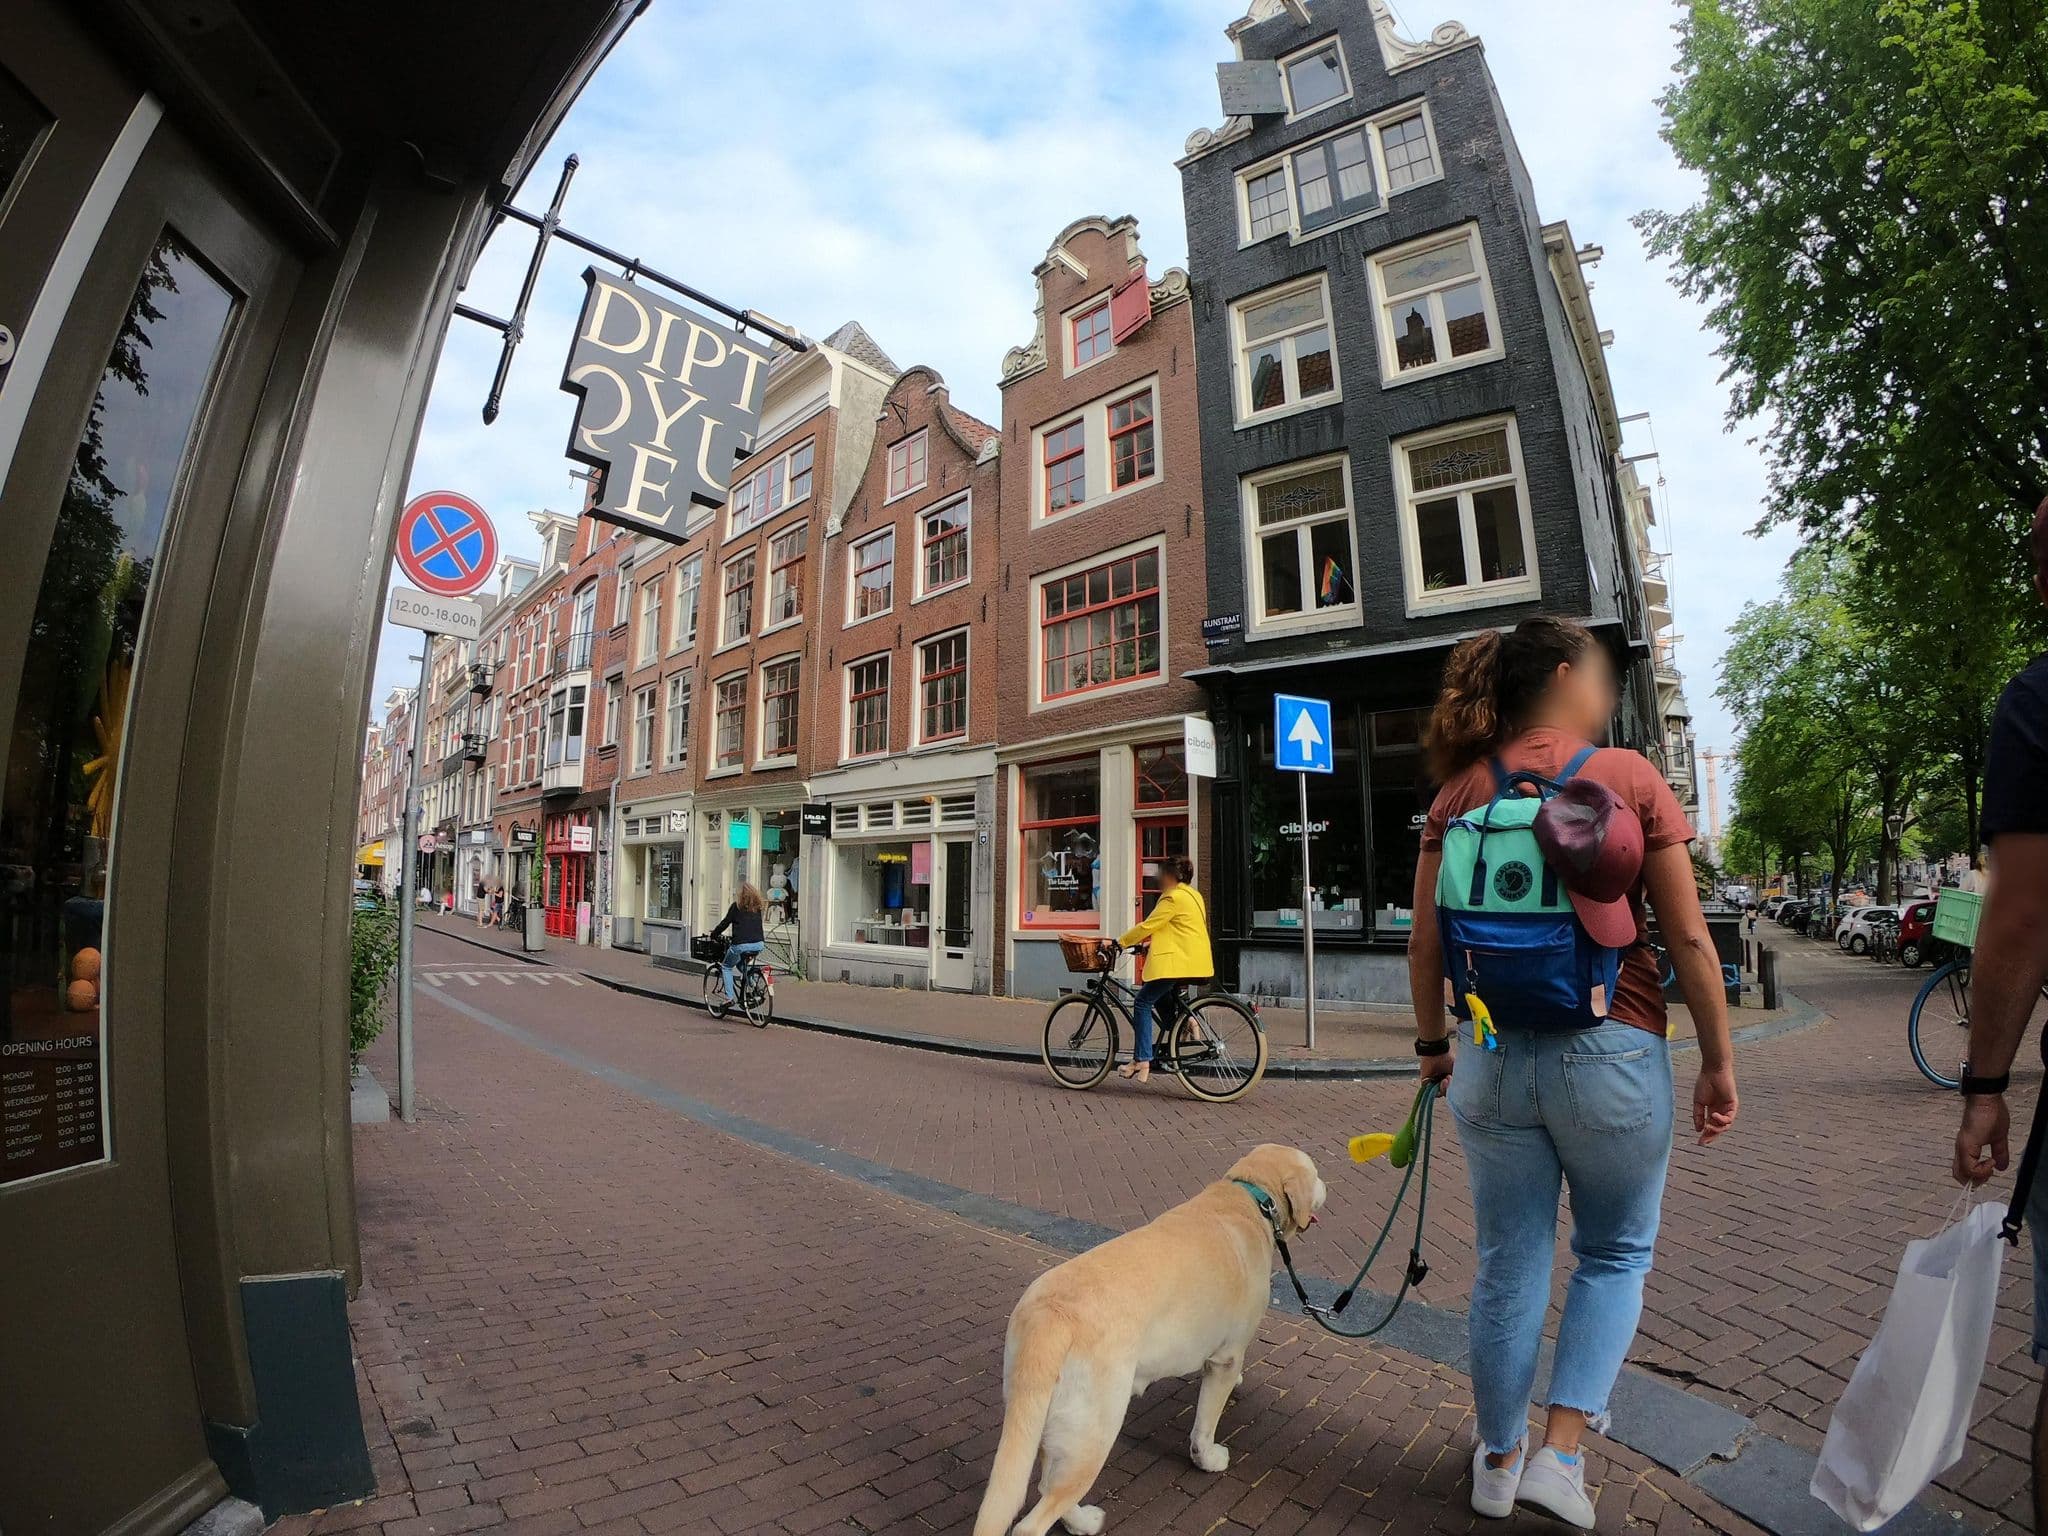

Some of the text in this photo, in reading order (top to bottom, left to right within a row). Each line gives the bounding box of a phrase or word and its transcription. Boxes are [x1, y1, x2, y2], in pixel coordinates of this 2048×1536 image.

[580, 281, 770, 414] DIPT
[614, 442, 679, 526] E
[395, 598, 476, 628] 12.00-18.00h
[1411, 815, 1428, 824] CB
[3, 1036, 92, 1056] OPENING HOURS
[3, 1071, 33, 1080] MONDAY
[3, 1084, 34, 1094] TUESDAY
[4, 1094, 48, 1107] WEDNESDAY
[5, 1109, 42, 1120] THURSDAY
[5, 1124, 30, 1134] FRIDAY
[6, 1134, 43, 1147] SATURDAY
[7, 1149, 35, 1159] SUNDAY
